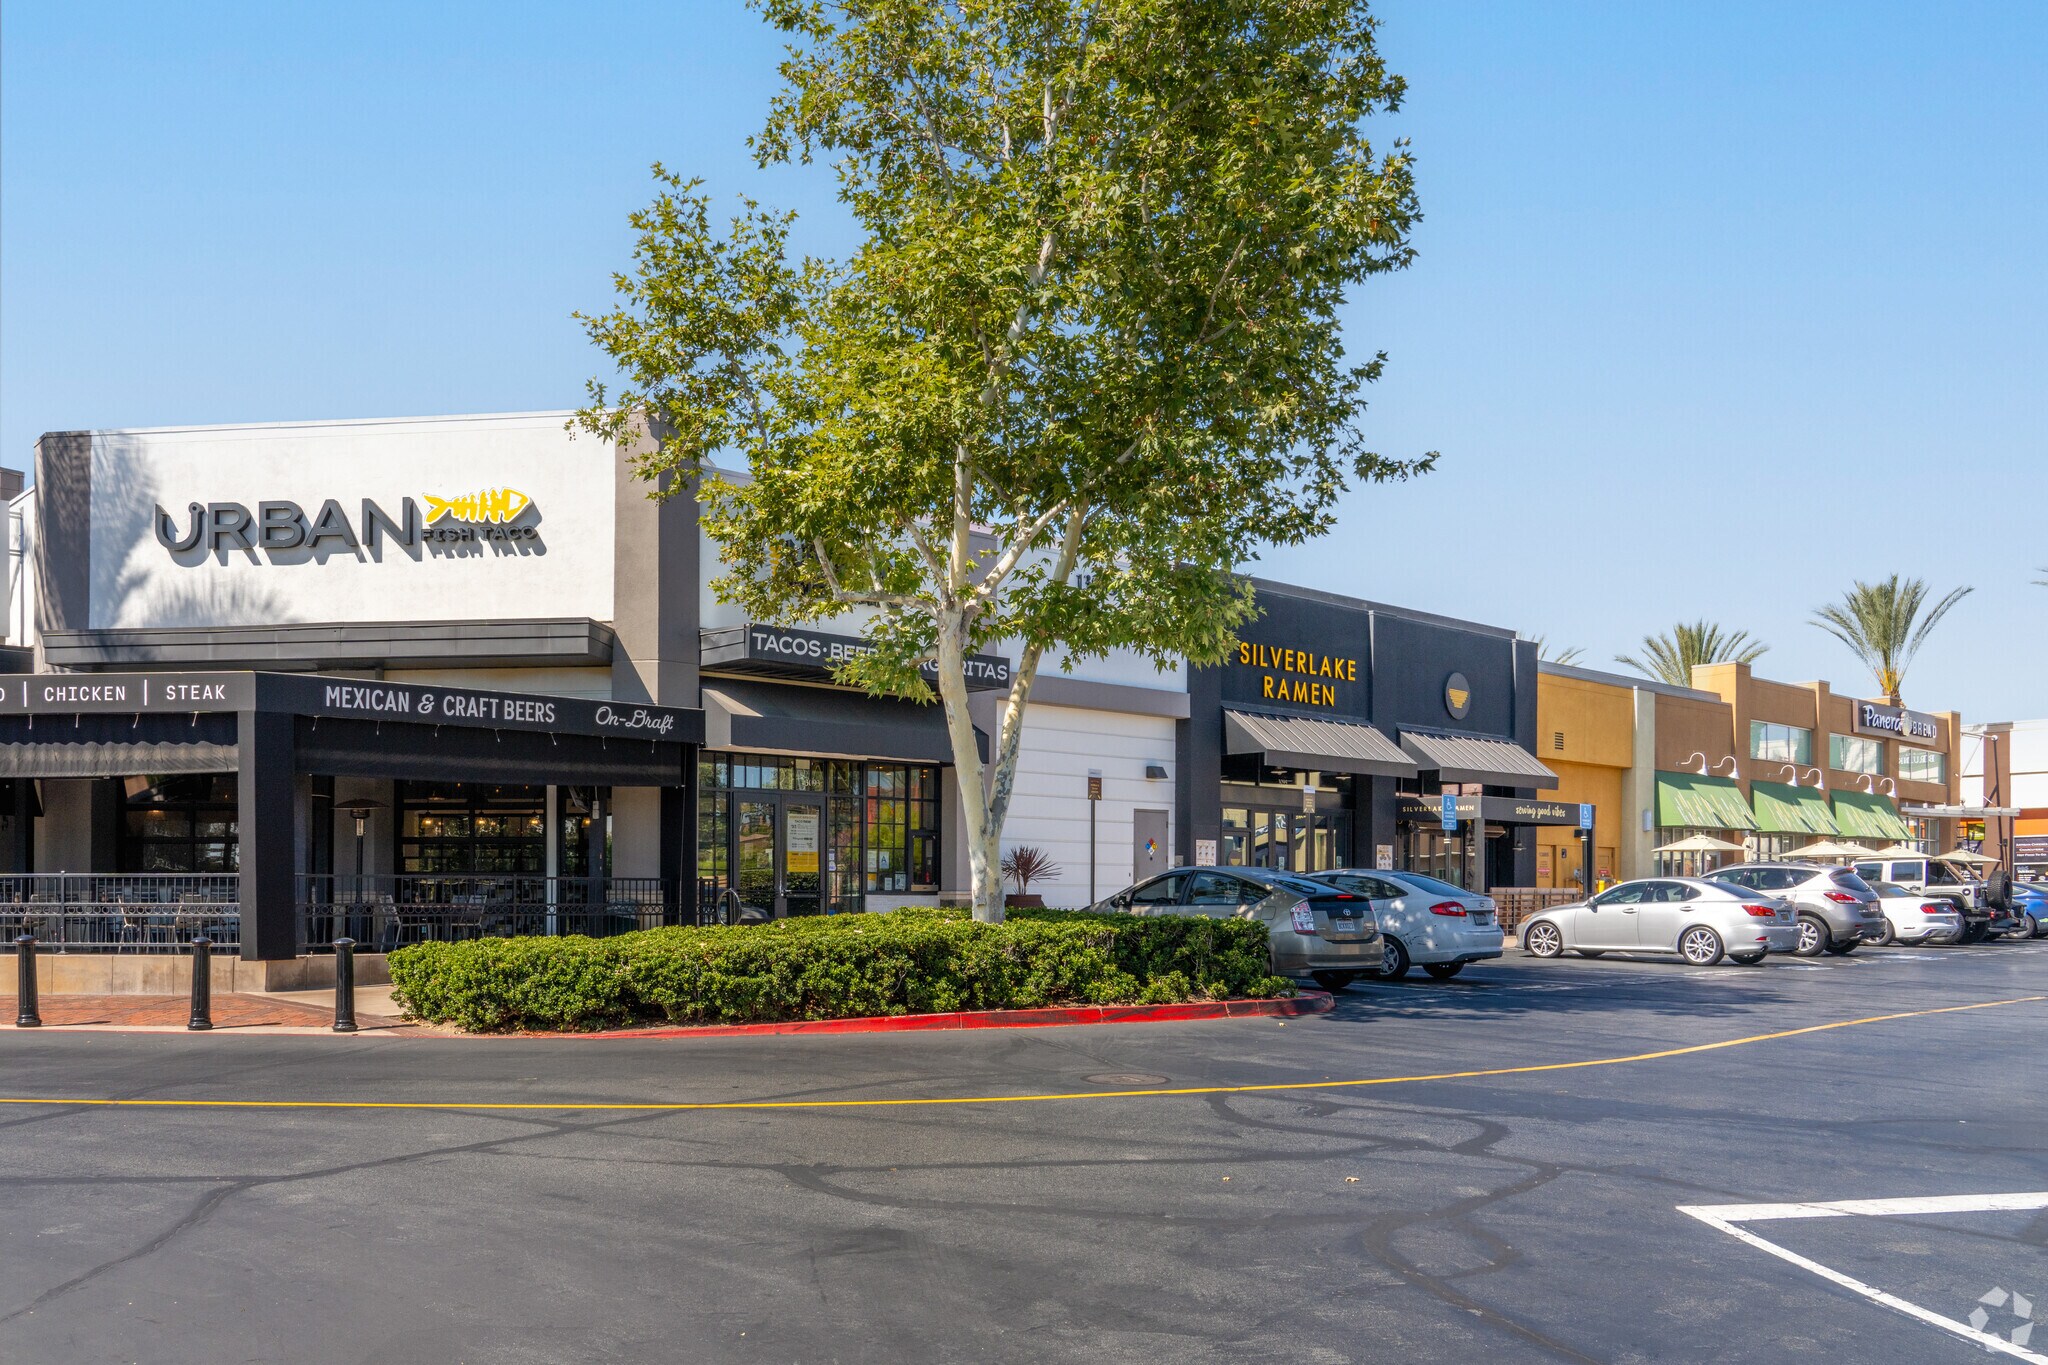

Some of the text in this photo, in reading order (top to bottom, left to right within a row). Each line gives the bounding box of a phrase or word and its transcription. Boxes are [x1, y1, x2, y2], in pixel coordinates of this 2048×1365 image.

[155, 497, 417, 552] URBAN
[421, 525, 538, 542] FISH TACO
[752, 632, 821, 658] TACOS
[1239, 642, 1357, 682] SILVERLAKE
[44, 684, 226, 702] CHICKEN STEAK
[325, 686, 556, 723] MEXICAN & CRAFT BEERS
[1263, 675, 1335, 707] RAMEN
[595, 705, 675, 735] On-Draft
[1862, 704, 1937, 739] Panera BREAD
[1402, 804, 1475, 813] SILVERLAK AMEN
[1515, 805, 1566, 819] serving good vibes
